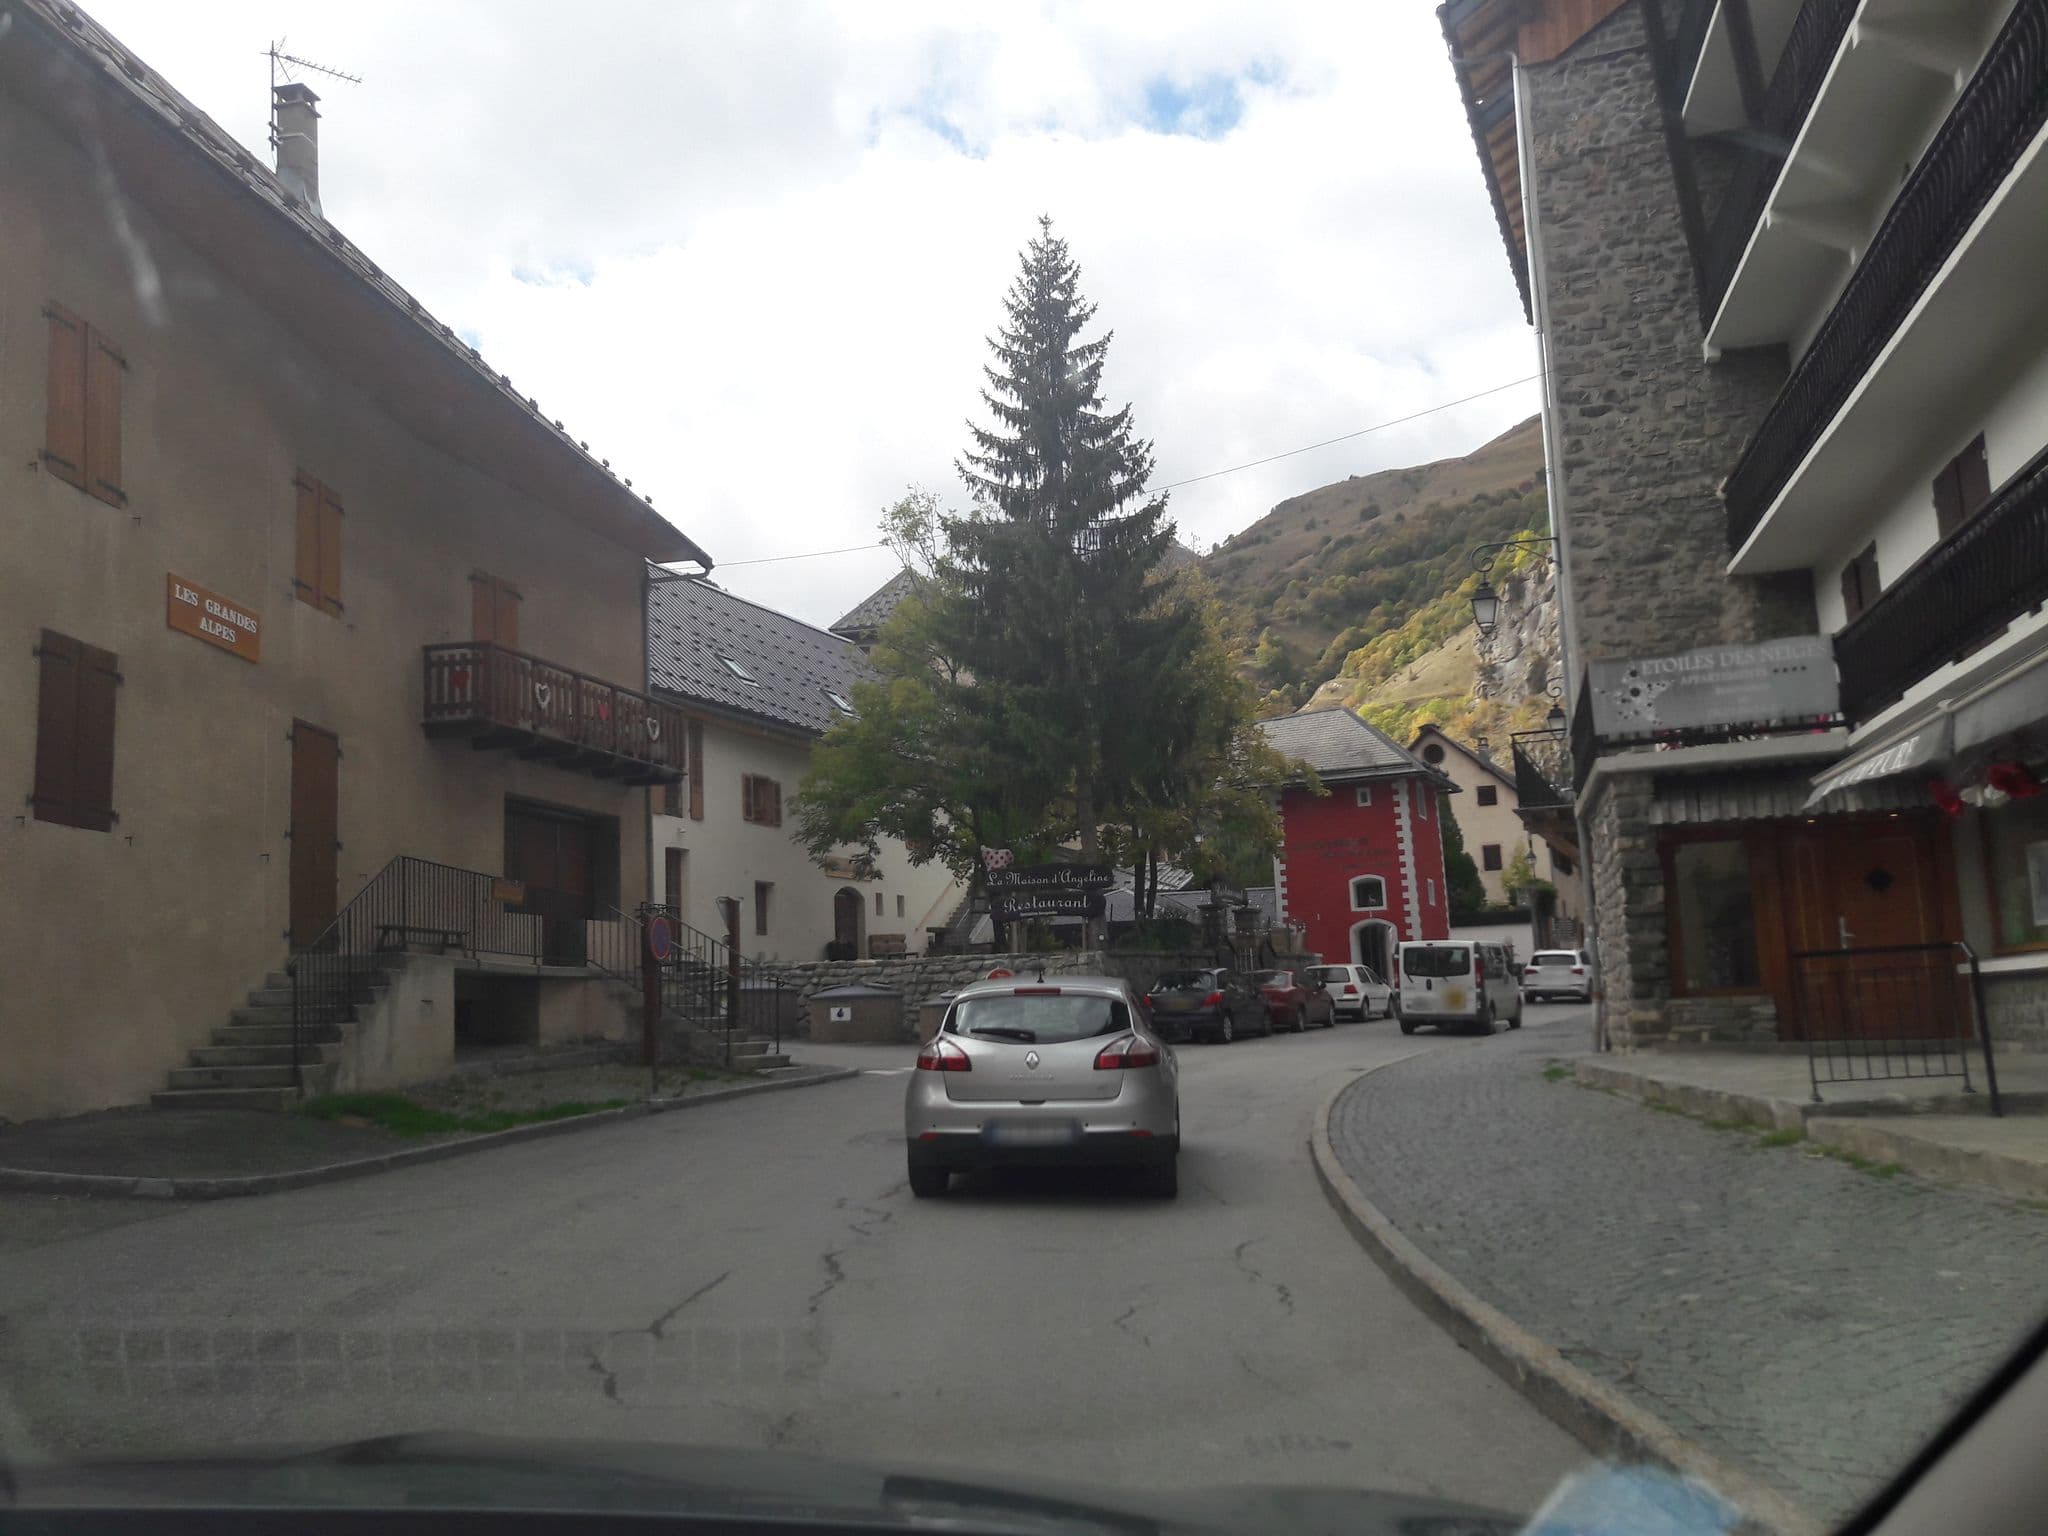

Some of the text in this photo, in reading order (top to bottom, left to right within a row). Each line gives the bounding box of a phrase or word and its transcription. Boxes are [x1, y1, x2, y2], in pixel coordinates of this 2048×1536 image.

[175, 584, 257, 633] LES GRANDES
[200, 617, 236, 642] ALPES
[1641, 644, 1827, 675] ETOILES DES NEIGES
[986, 868, 1109, 888] La Maison d'Angeline
[1003, 896, 1089, 912] Restaurant
